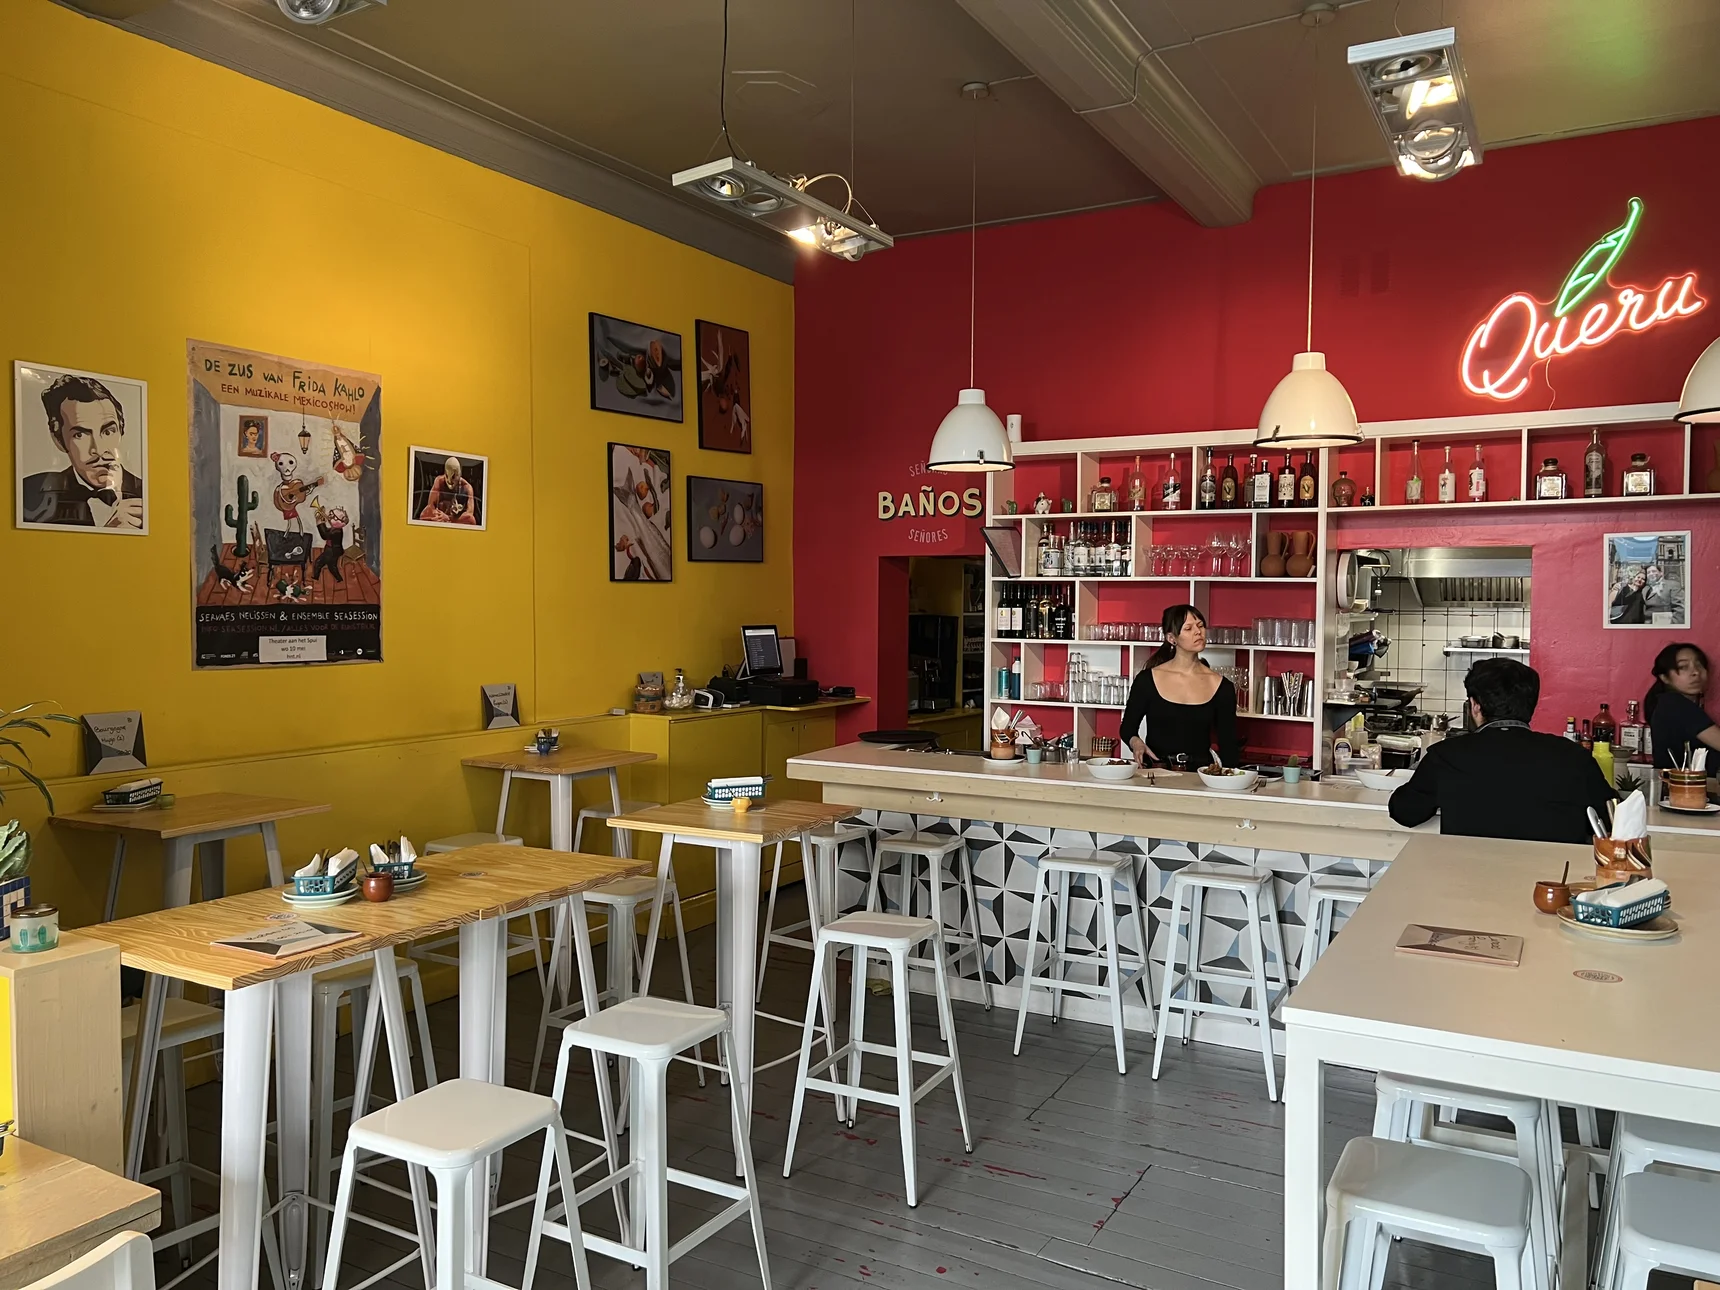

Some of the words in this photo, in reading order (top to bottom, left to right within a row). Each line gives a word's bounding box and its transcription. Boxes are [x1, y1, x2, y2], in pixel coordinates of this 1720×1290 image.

[1461, 275, 1703, 400] Queru
[204, 358, 221, 373] DE
[228, 363, 254, 378] ZUS
[263, 371, 284, 384] VAN
[333, 377, 365, 401] KAHLO
[221, 383, 240, 395] EEN
[878, 485, 983, 521] BAÑOS
[908, 528, 949, 543] SEÑORES
[199, 611, 236, 622] SERVAES
[279, 612, 288, 622] &
[291, 611, 330, 621] ENSEMBLE
[307, 637, 318, 645] Spui
